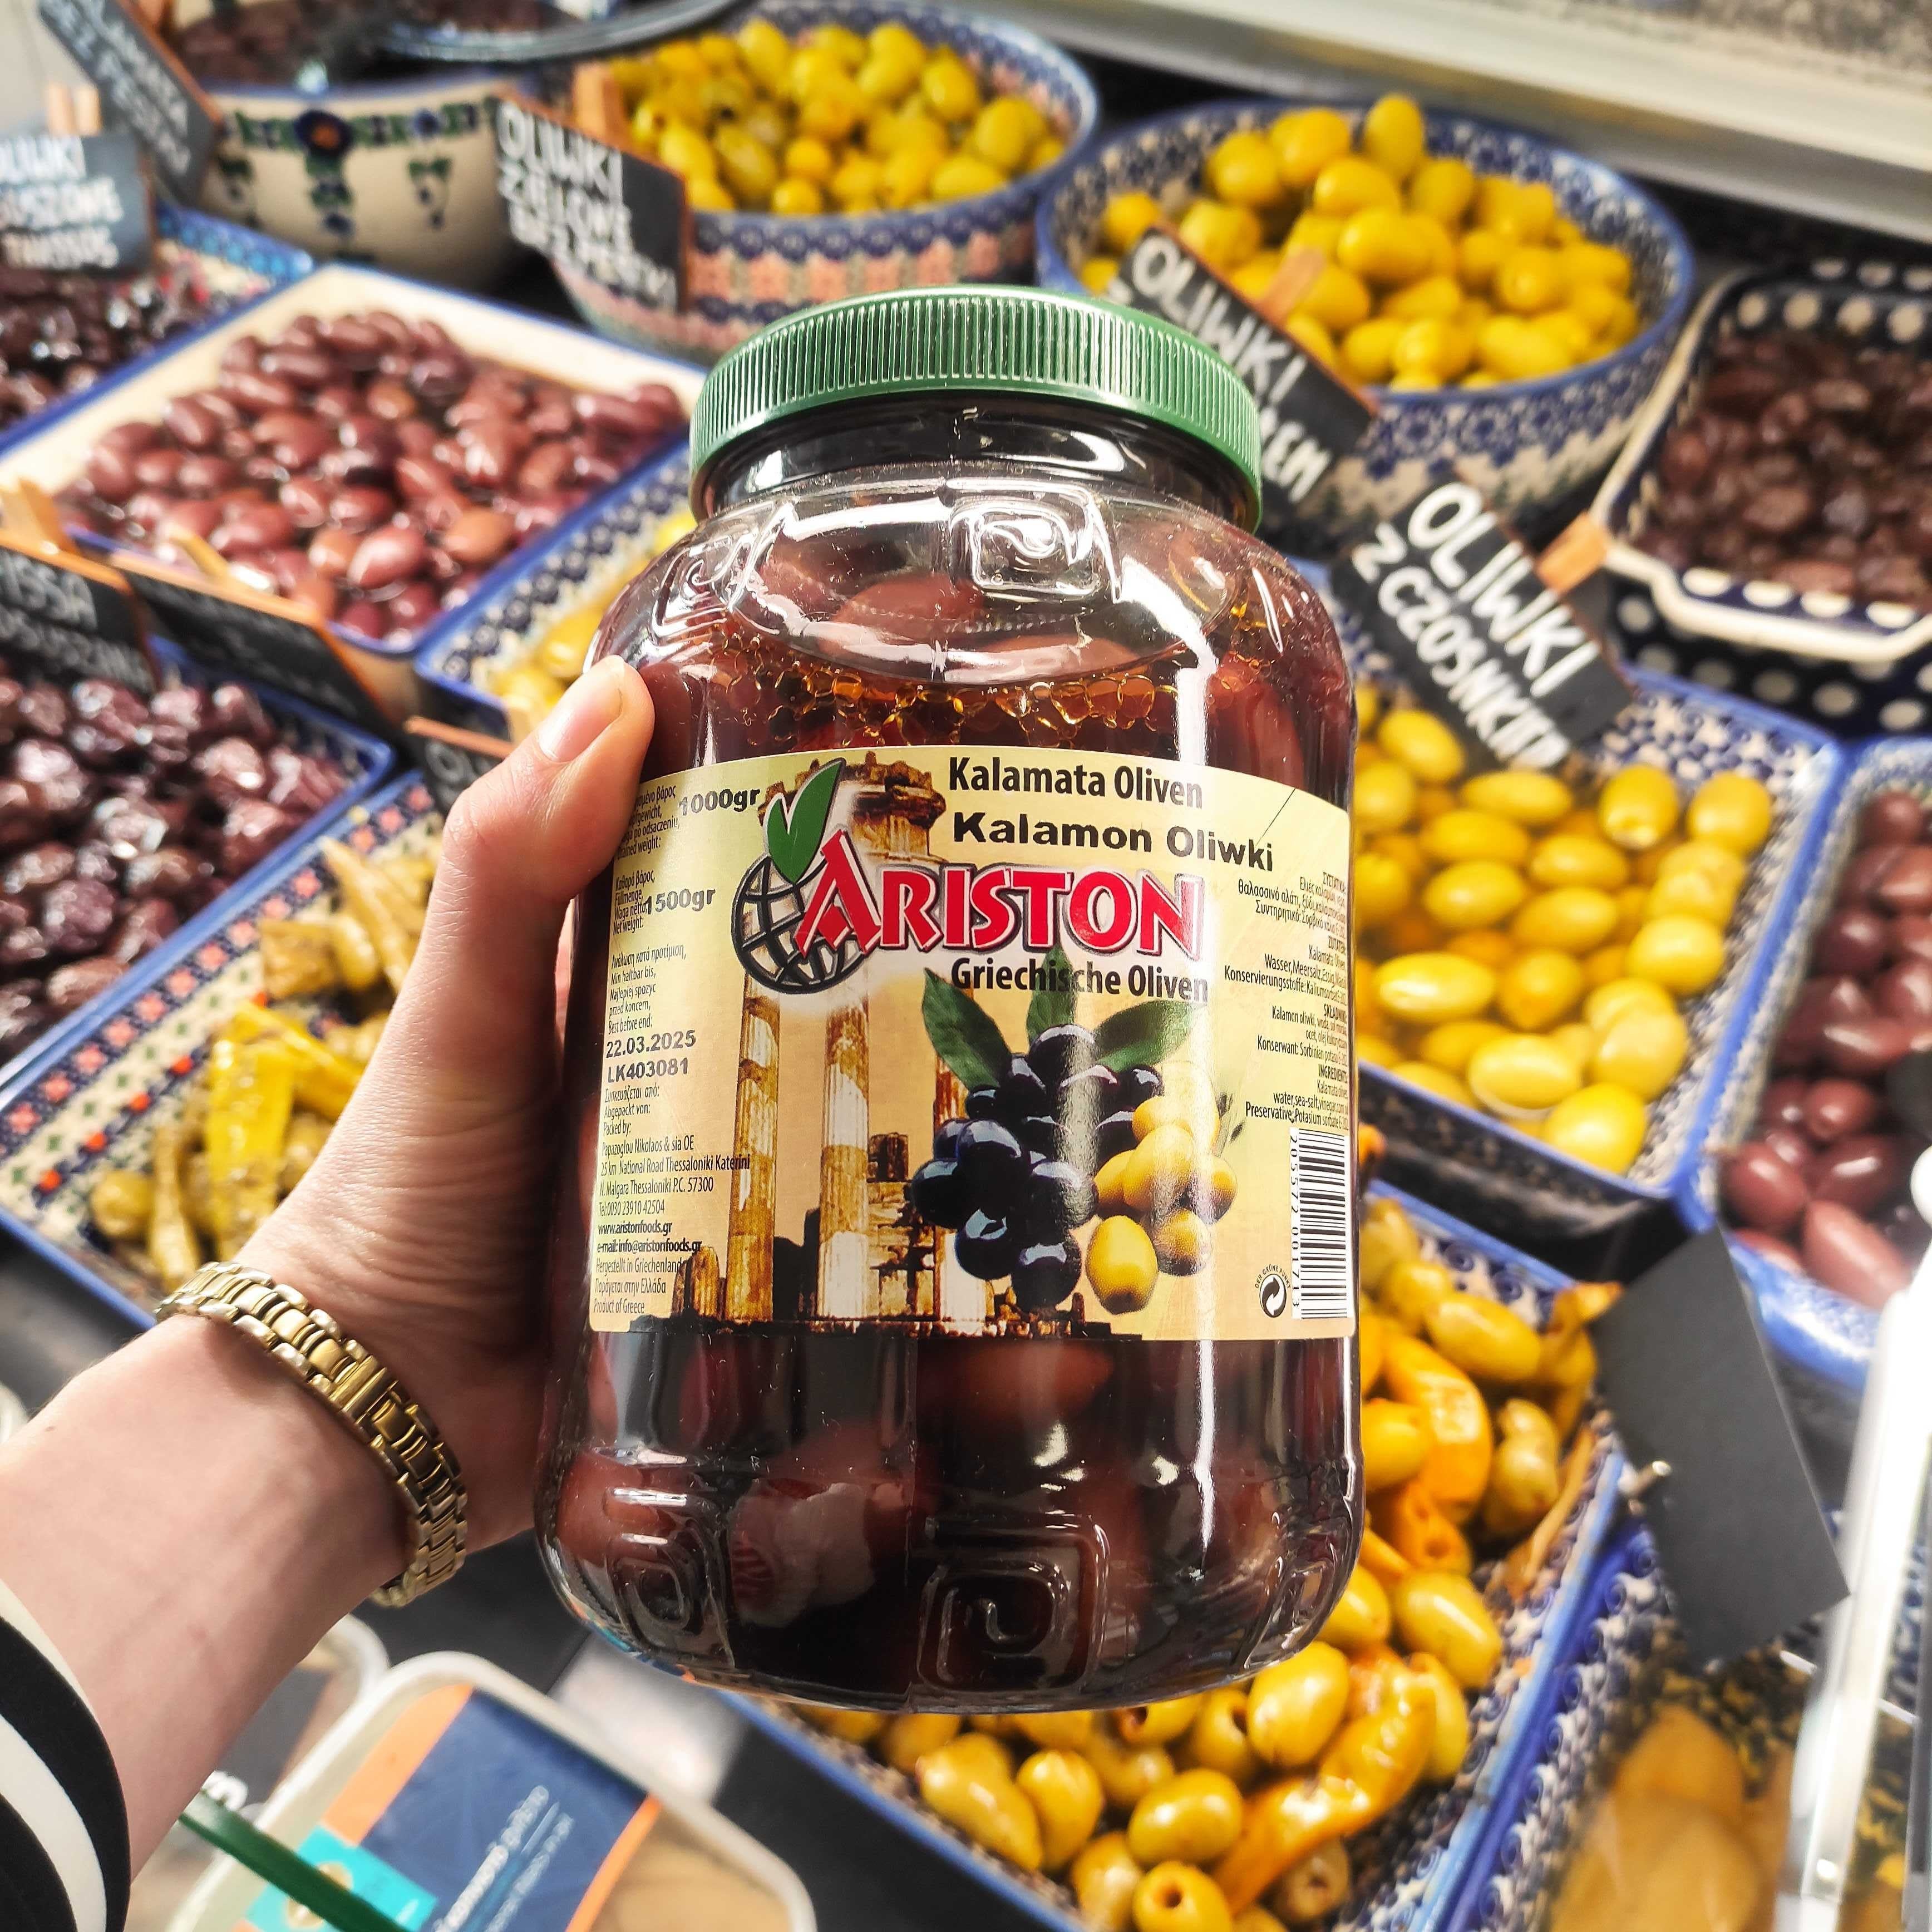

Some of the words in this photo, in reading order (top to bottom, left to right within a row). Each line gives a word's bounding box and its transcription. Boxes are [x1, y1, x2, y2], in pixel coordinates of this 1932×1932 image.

[1132, 235, 1308, 406] OLIWKI
[1351, 522, 1407, 583] Z
[1408, 482, 1600, 698] OLIWKI
[949, 757, 1105, 796] Kalamata
[1114, 767, 1203, 809] Oliven
[656, 785, 676, 804] βάρος
[679, 788, 761, 816] 1000gr
[634, 827, 642, 839] po
[954, 812, 1152, 852] Kalamon
[1165, 824, 1273, 871] Oliwki
[638, 835, 661, 854] weight:
[615, 874, 634, 889] Καθαρό
[635, 869, 655, 886] βάρος,
[645, 889, 715, 914] 1500gr
[793, 828, 1205, 963] ARISTON
[614, 906, 629, 921] Waga
[613, 921, 622, 935] Net
[622, 917, 644, 932] weight:
[635, 948, 649, 963] κατά
[1309, 944, 1334, 966] Kalamata
[612, 973, 621, 985] Min
[622, 969, 643, 983] haltbar
[644, 966, 655, 979] bis,
[952, 957, 1121, 998] Griechische
[1127, 971, 1208, 1002] Oliven
[609, 1005, 624, 1018] przed
[624, 1001, 650, 1014] koncem,
[1272, 1005, 1298, 1023] Kalamon
[1300, 1011, 1316, 1028] oliwki,
[609, 1020, 619, 1034] Best
[620, 1016, 638, 1032] before
[639, 1014, 652, 1028] end:
[606, 1029, 696, 1058] 22.03.2025
[1258, 1035, 1299, 1055] Konserwant:
[608, 1057, 689, 1083] LK403081
[644, 1083, 659, 1098] από:
[604, 1105, 634, 1122] Abgepackt
[635, 1103, 650, 1115] von:
[604, 1122, 622, 1136] Packed
[622, 1122, 631, 1135] by:
[602, 1141, 633, 1159] Papazoglou
[635, 1138, 662, 1152] Nikolaos
[664, 1138, 669, 1151] &
[672, 1137, 682, 1151] sia
[684, 1135, 694, 1150] OE
[601, 1162, 608, 1176] 25
[608, 1161, 617, 1171] km
[619, 1159, 645, 1174] National
[647, 1158, 664, 1173] Road
[666, 1155, 713, 1172] Thessaloniki
[716, 1154, 750, 1170] Katerini
[600, 1184, 605, 1196] N.
[607, 1180, 629, 1199] Malgara
[630, 1177, 672, 1194] Thessaloniki
[688, 1177, 713, 1192] 57300
[622, 1201, 641, 1215] 23910
[643, 1200, 665, 1214] 42504
[598, 1219, 672, 1237] www.aristonfoods.gr
[597, 1257, 625, 1273] Hergestellt
[627, 1256, 633, 1273] in
[624, 1281, 639, 1297] στην
[641, 1278, 666, 1294] Ελλάδα
[1254, 1273, 1263, 1289] DER
[594, 1298, 615, 1313] Product
[615, 1299, 622, 1313] of
[623, 1298, 645, 1313] Greece
